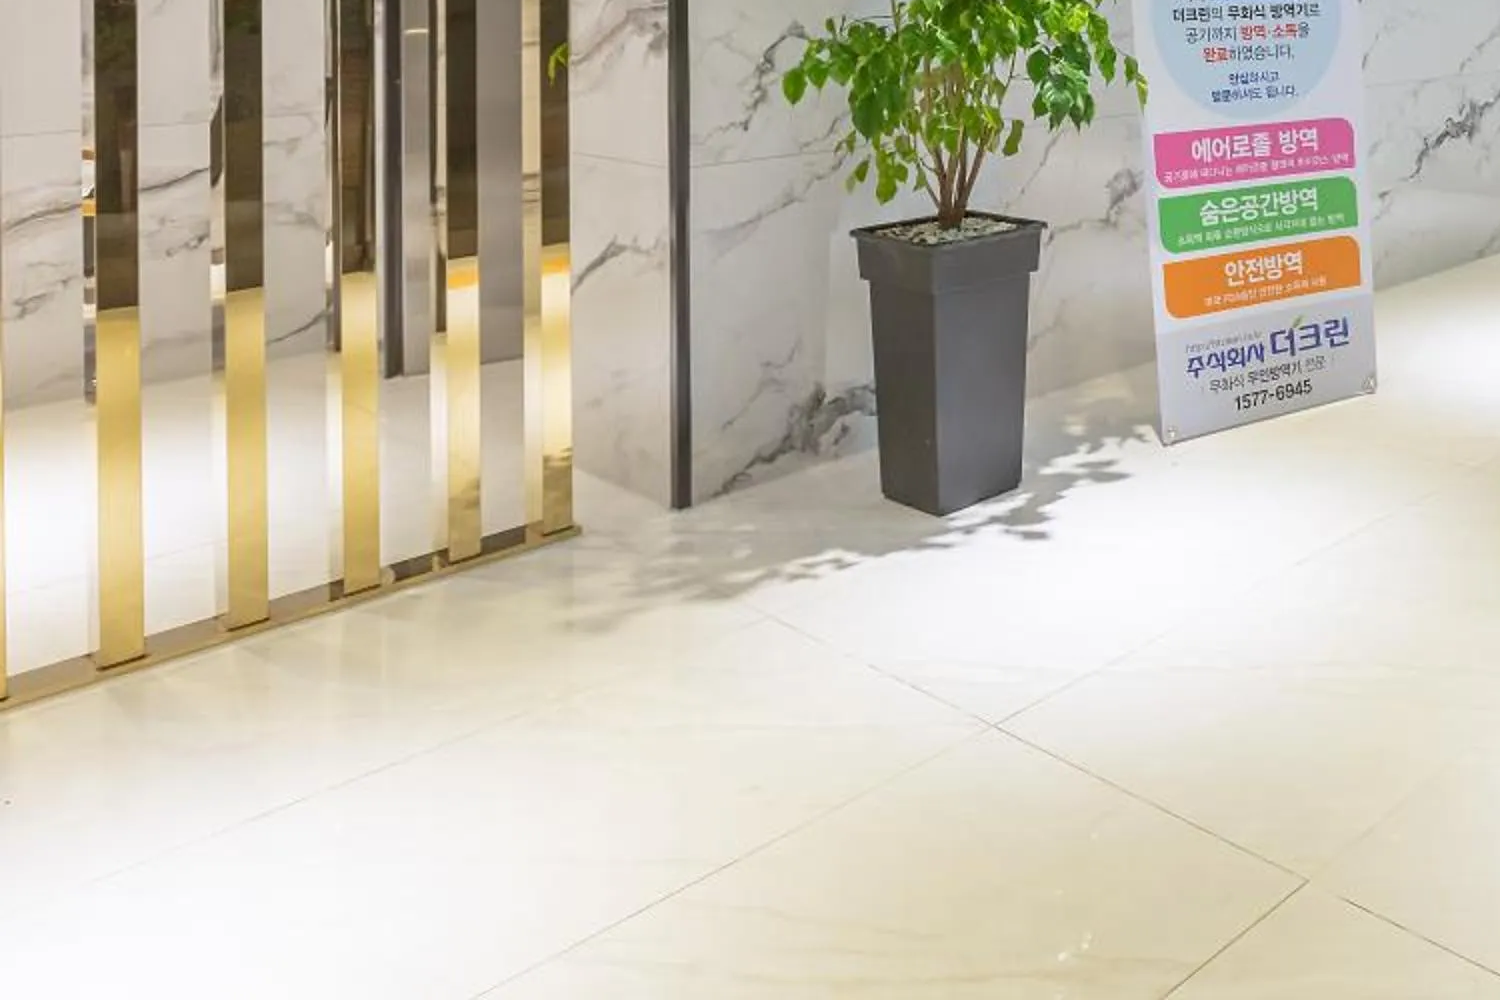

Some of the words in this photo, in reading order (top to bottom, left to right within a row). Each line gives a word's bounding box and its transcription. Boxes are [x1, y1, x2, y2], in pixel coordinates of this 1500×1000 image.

[1185, 25, 1238, 44] 공기까지
[1191, 132, 1271, 162] 에어로졸
[1279, 128, 1318, 155] 방역
[1200, 187, 1318, 226] 숨은공간방역
[1224, 250, 1303, 287] 안전방역
[1186, 341, 1265, 378] 주식회사
[1270, 316, 1350, 356] 더크린
[1234, 378, 1313, 411] 1577-6945
